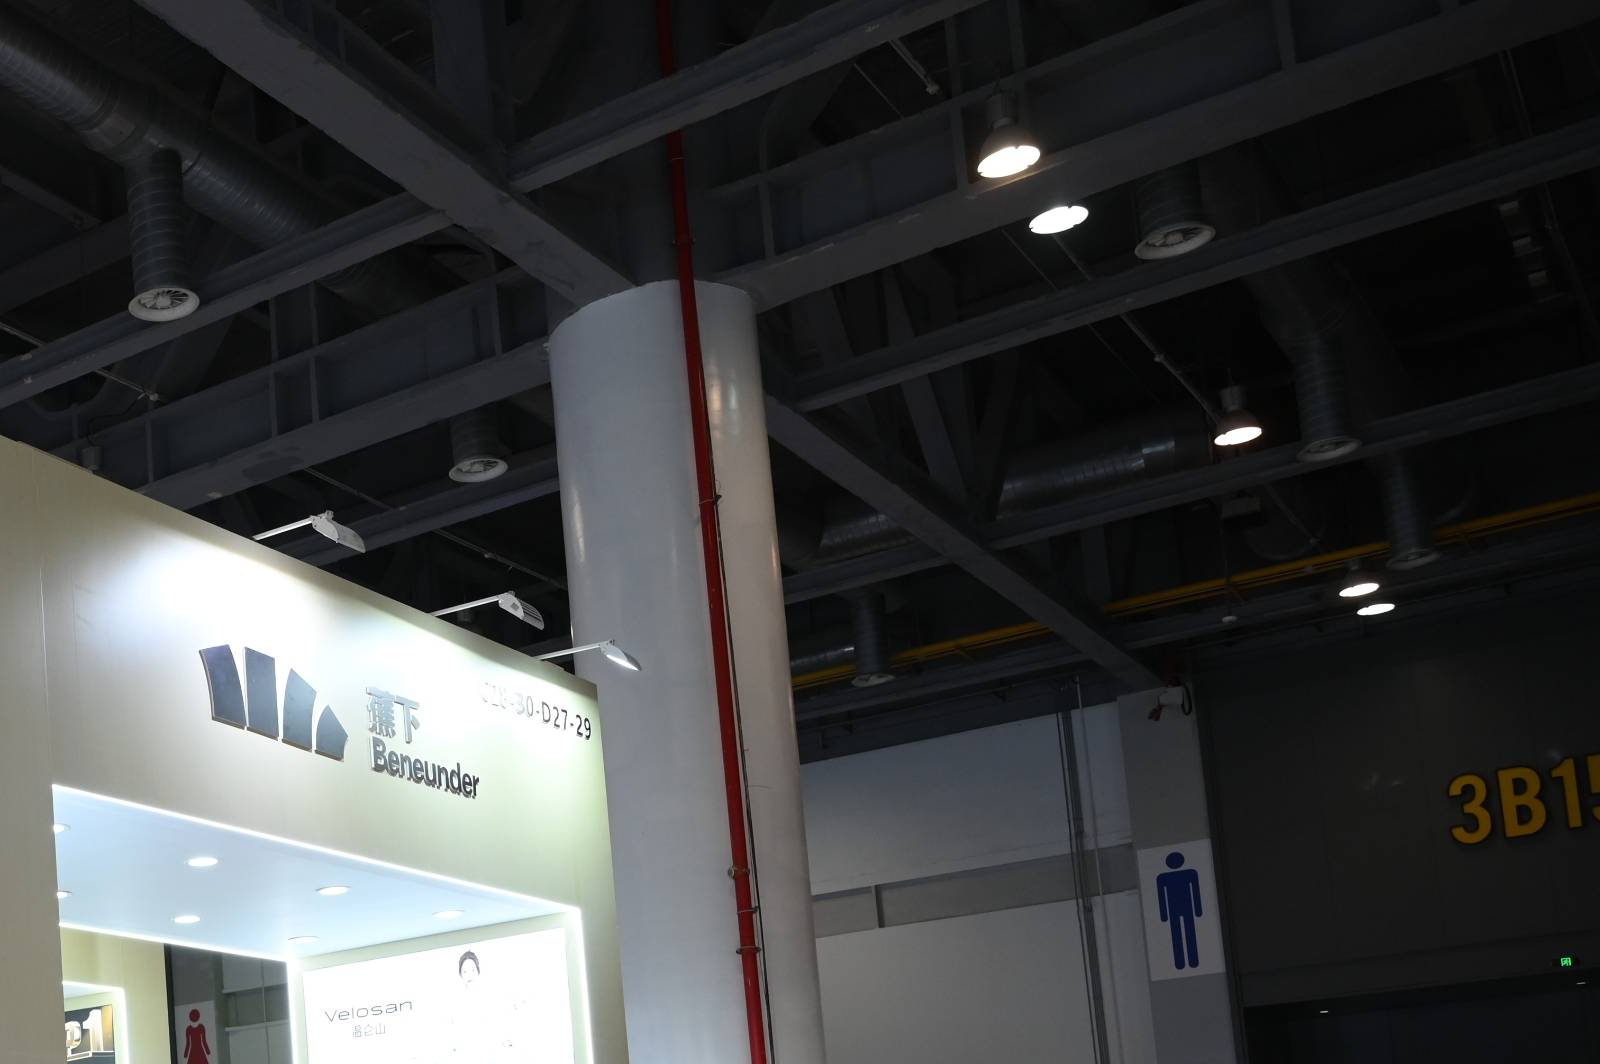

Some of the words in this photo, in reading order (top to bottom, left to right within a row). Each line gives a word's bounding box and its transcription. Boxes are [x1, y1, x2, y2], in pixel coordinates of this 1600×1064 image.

[365, 686, 420, 743] 蕉下
[369, 737, 480, 800] Beneunder
[324, 998, 414, 1023] Velosan
